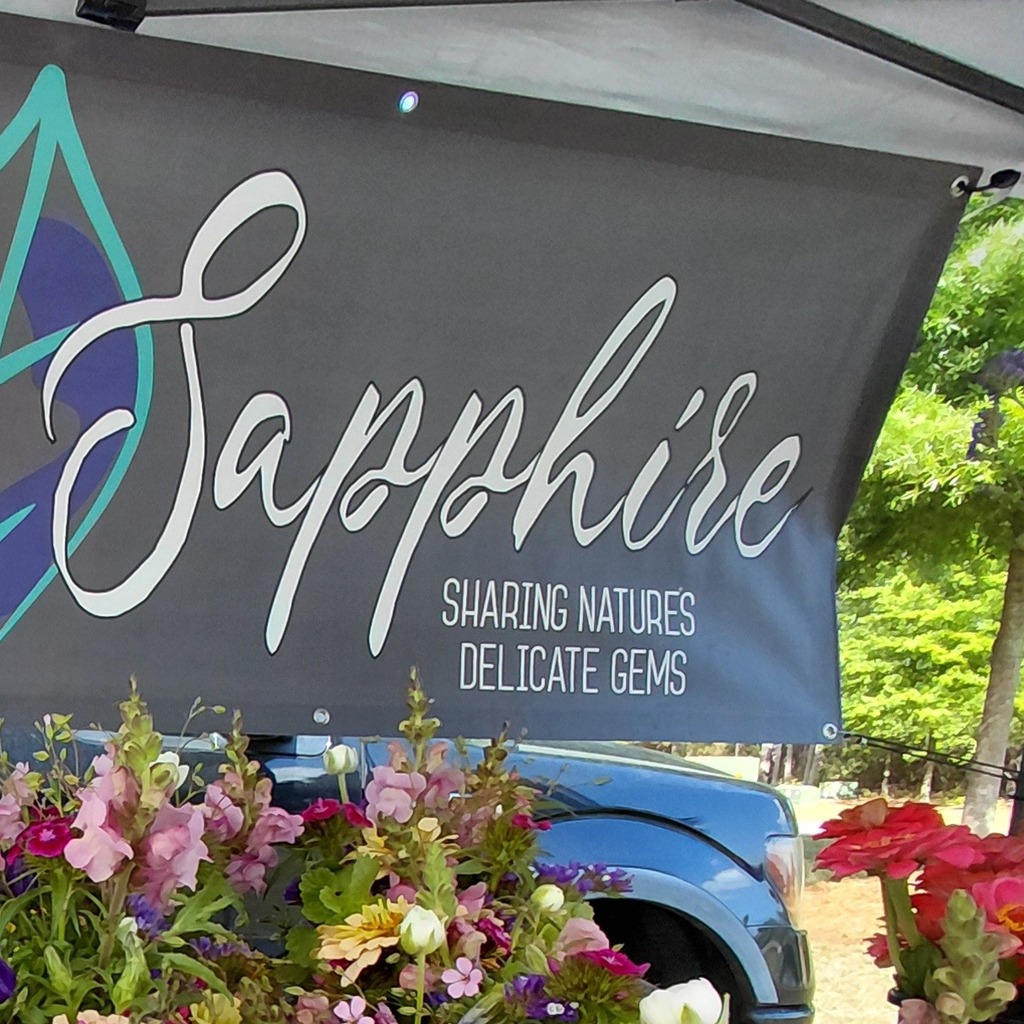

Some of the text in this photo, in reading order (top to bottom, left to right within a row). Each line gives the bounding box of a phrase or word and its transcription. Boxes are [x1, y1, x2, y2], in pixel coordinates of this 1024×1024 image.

[42, 169, 816, 656] Sapphire
[441, 577, 569, 631] SHARING
[459, 641, 688, 696] DELICATE GEMS
